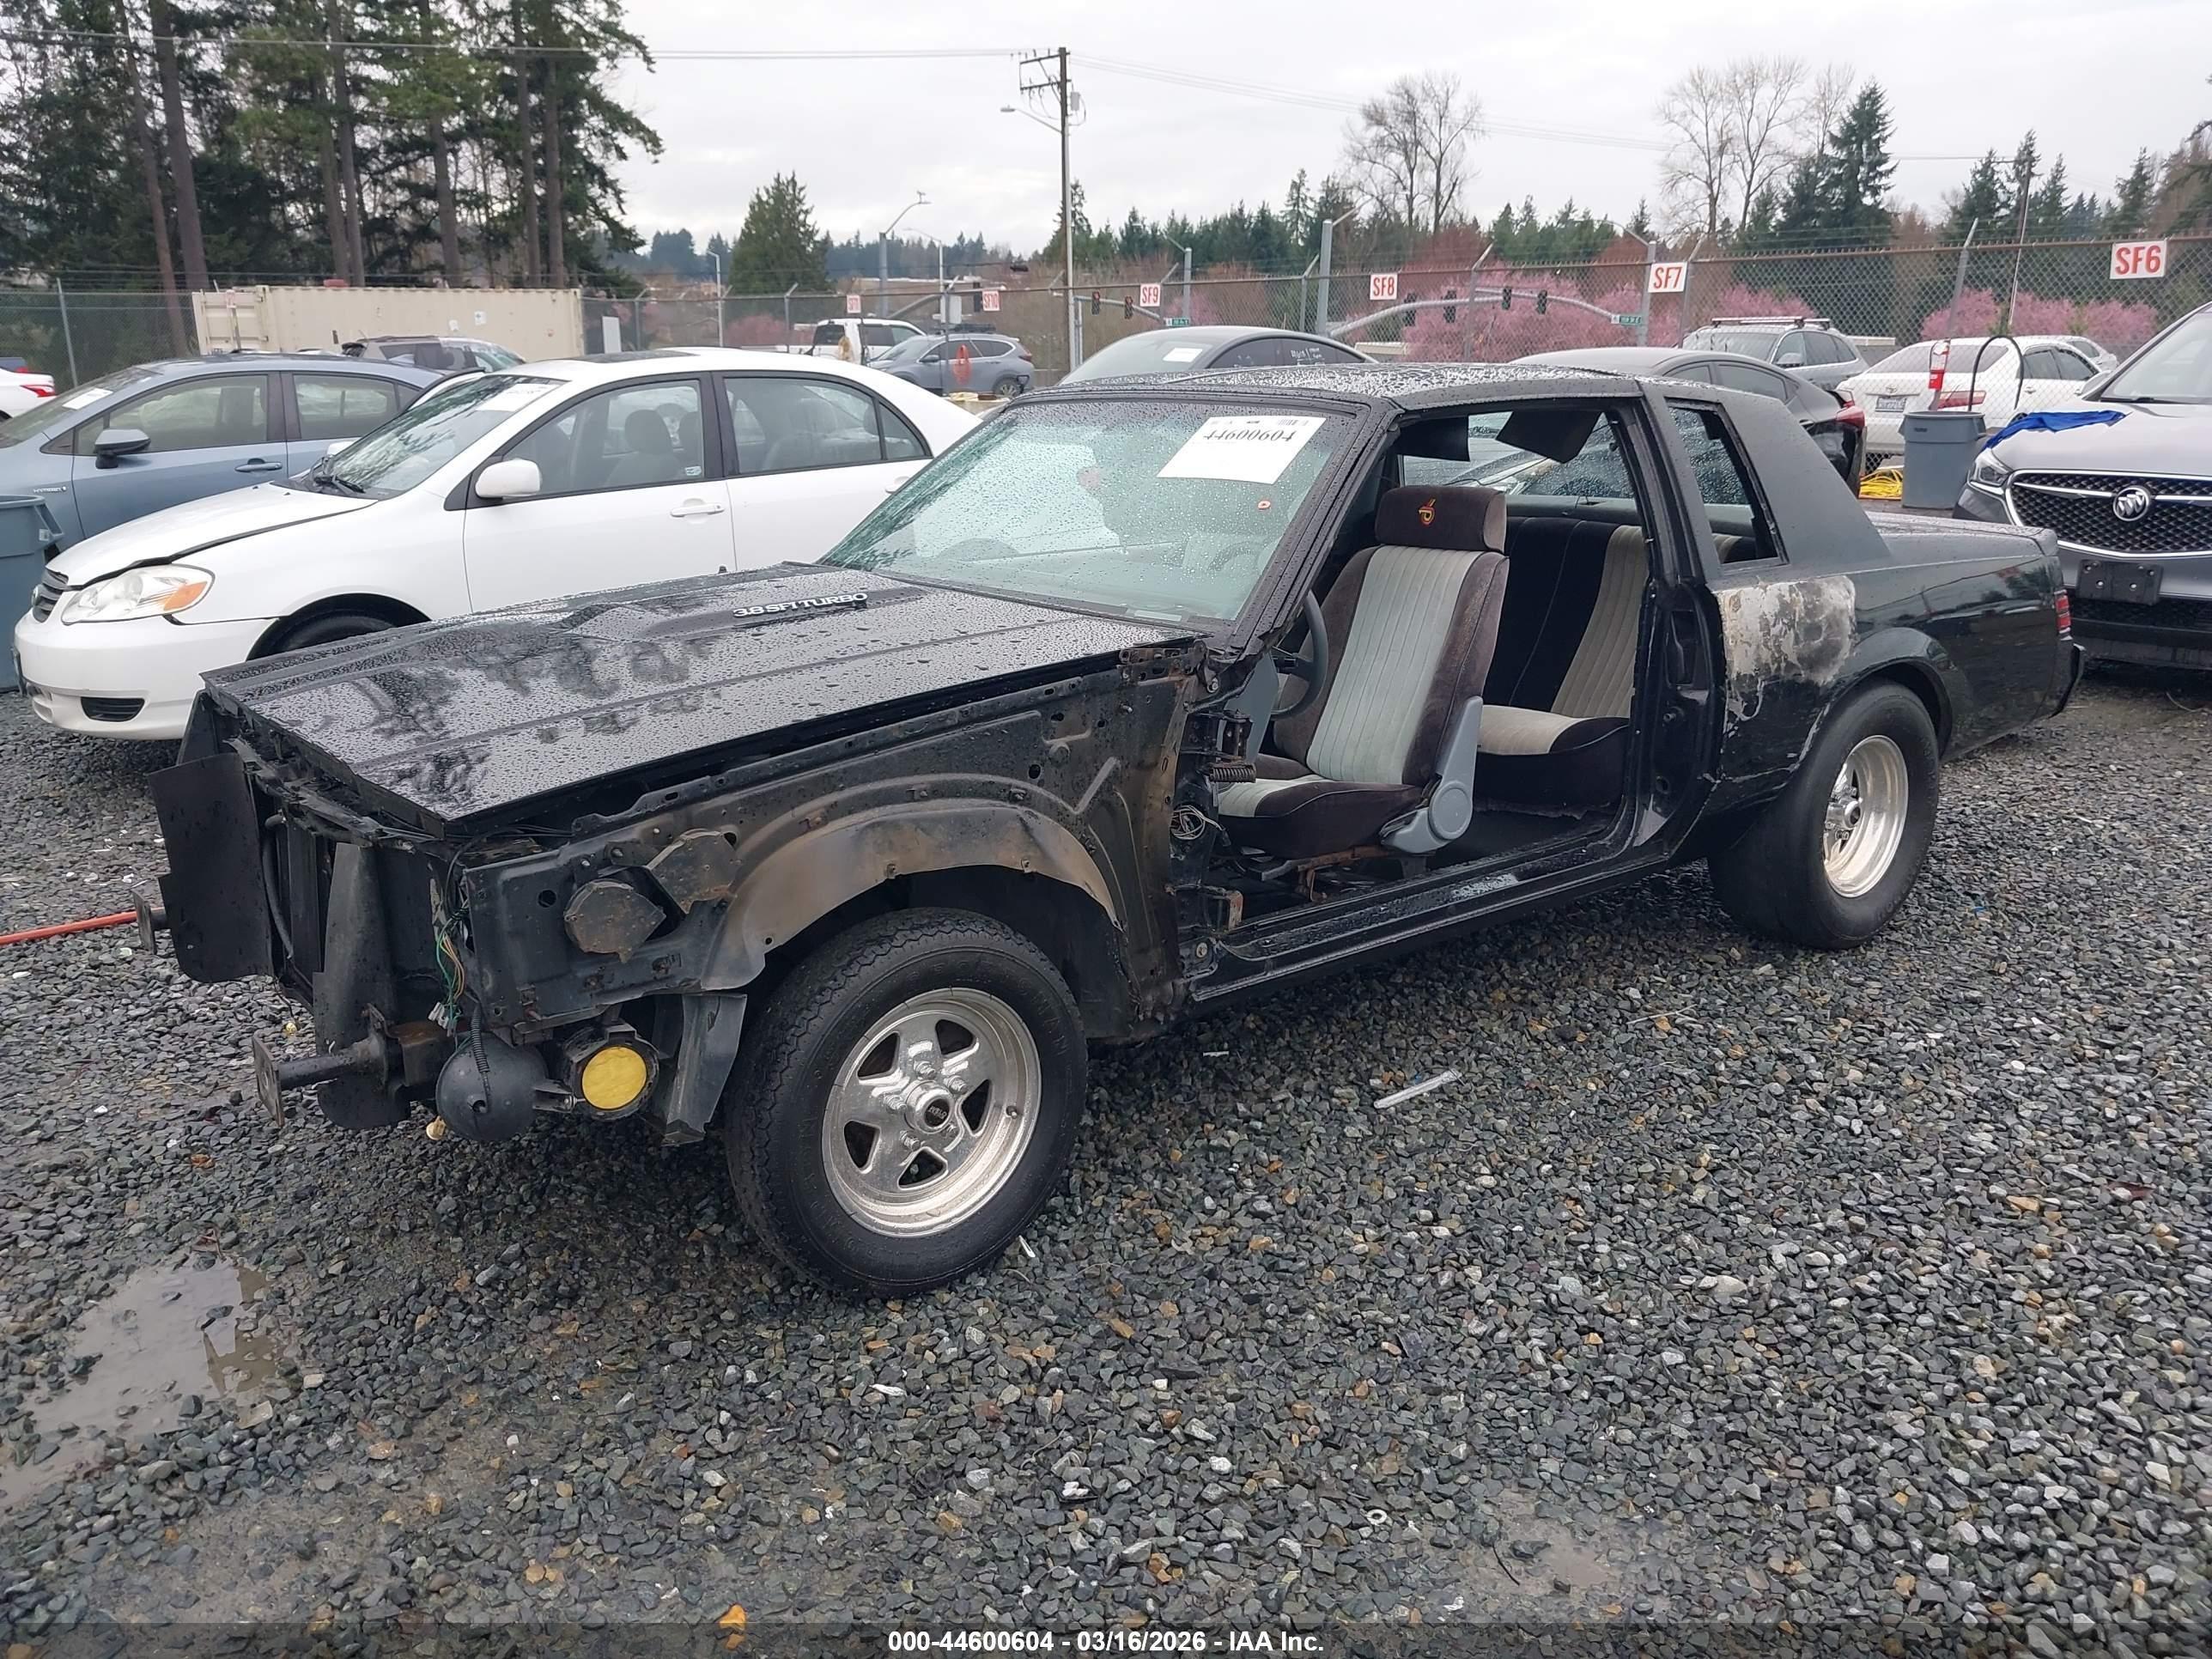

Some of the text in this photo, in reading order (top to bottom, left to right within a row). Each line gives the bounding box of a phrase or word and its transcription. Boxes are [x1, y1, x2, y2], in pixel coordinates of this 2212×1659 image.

[2115, 245, 2161, 275] SF6
[1373, 276, 1395, 296] SF8
[1653, 266, 1683, 289] SF7
[1142, 286, 1159, 304] SF9
[1203, 429, 1297, 442] 44600604
[732, 592, 868, 617] 3.8 SFI TURBO
